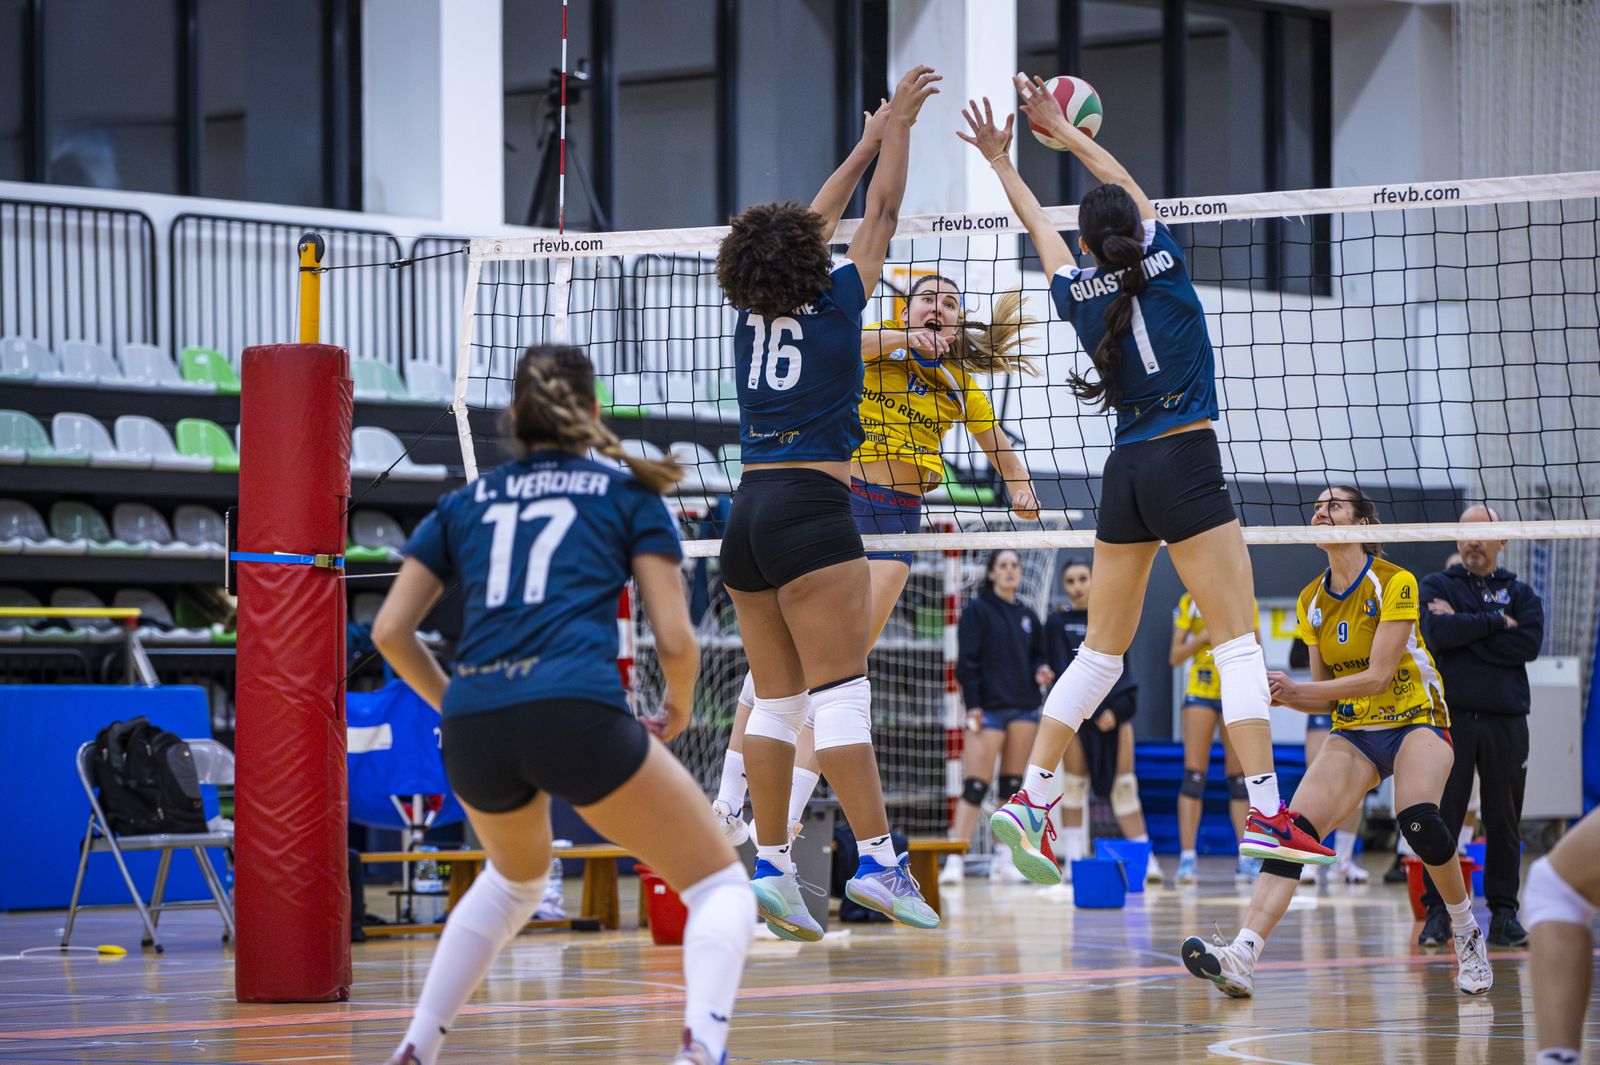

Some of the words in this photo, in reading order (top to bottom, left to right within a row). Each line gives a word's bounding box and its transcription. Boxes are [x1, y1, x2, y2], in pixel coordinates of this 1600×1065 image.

[1373, 186, 1460, 204] rfevb.com
[1154, 200, 1228, 218] fevb.com
[932, 215, 1009, 232] rfevb.com
[533, 238, 603, 253] rfevb.com
[1069, 250, 1175, 302] GUASTINO
[745, 313, 804, 391] 16
[474, 478, 498, 502] L.
[506, 470, 610, 499] VERDIER
[481, 497, 578, 608] 17
[1337, 620, 1349, 645] 9
